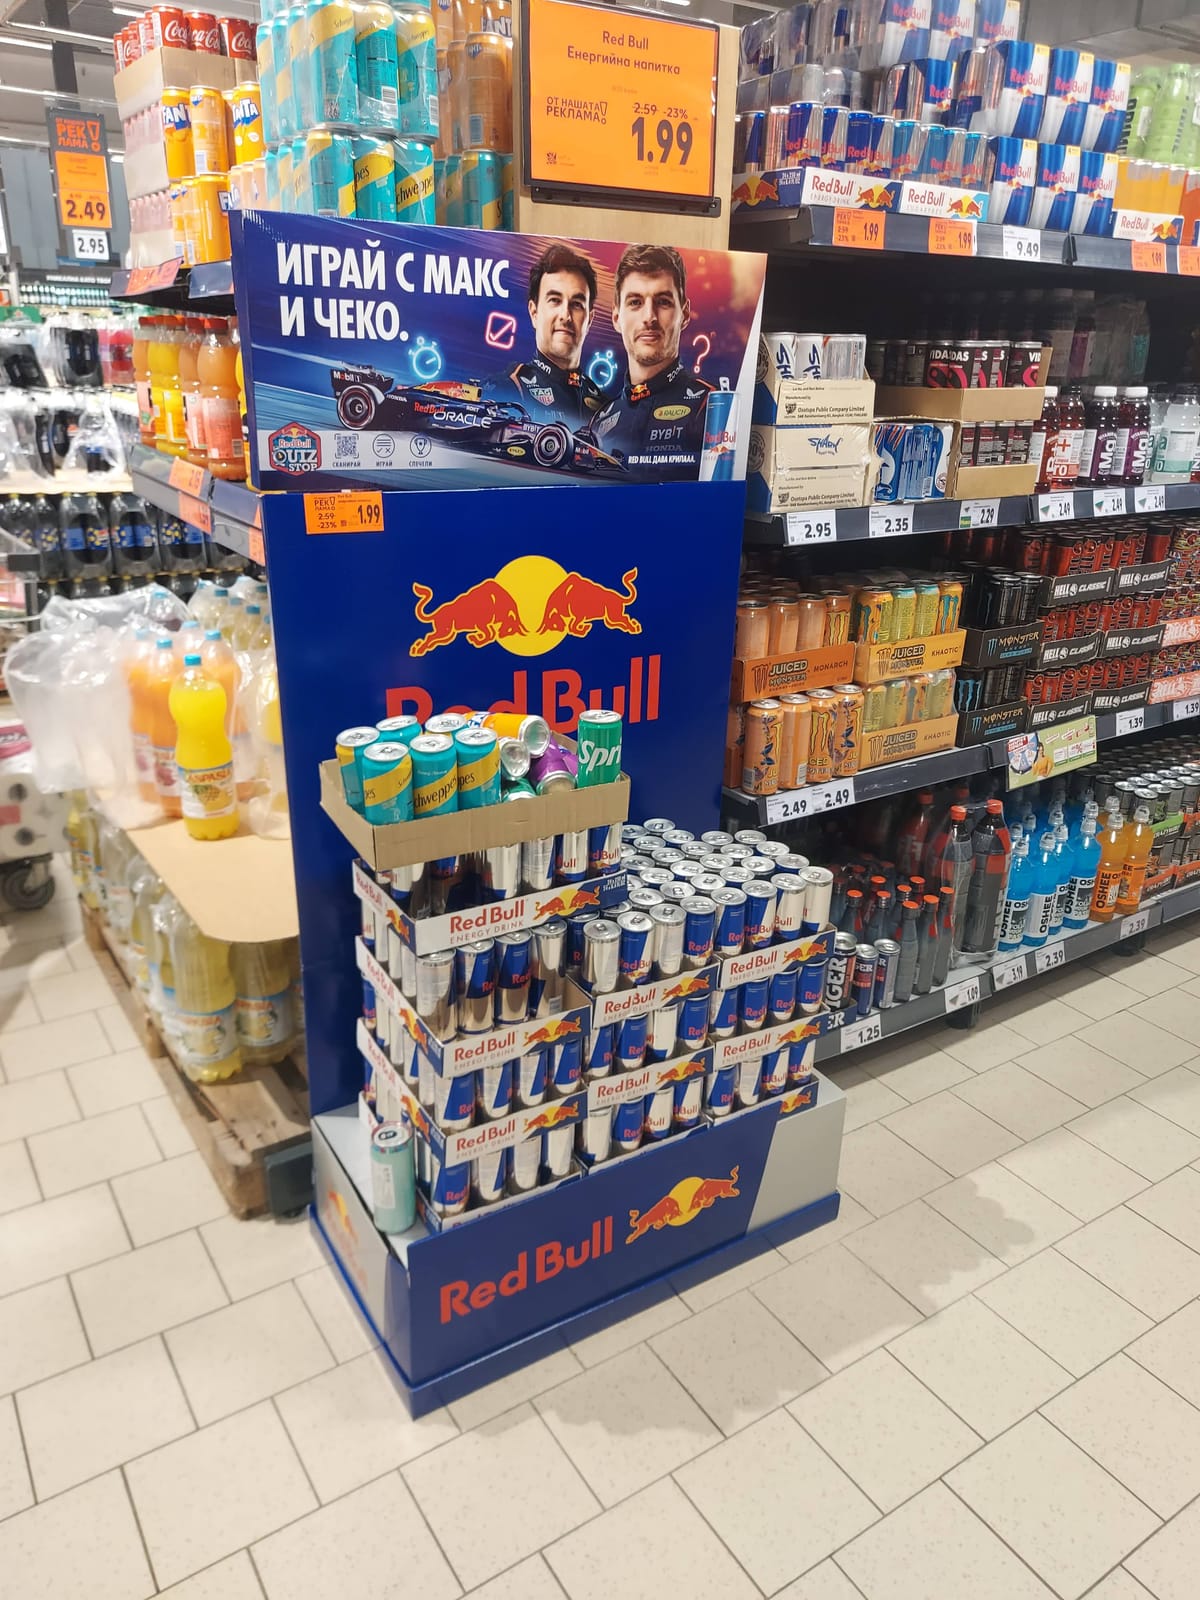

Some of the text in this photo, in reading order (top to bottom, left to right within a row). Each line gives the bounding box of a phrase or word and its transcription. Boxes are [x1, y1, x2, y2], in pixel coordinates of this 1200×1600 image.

[602, 31, 649, 50] Red Bull
[567, 46, 681, 75] Енергийна напитка
[546, 96, 600, 112] ОТ НАШАТА
[633, 102, 689, 120] 2.59 -23%
[546, 106, 601, 123] РЕКЛАМА
[632, 116, 693, 166] 1.99
[812, 176, 833, 192] Red
[834, 180, 853, 196] Bull
[908, 189, 945, 206] Red Bull
[65, 199, 106, 221] 2.49
[864, 222, 879, 241] 1.99
[77, 237, 105, 254] 2.95
[1017, 241, 1039, 257] 9.49
[277, 239, 510, 298] ИГРАЙ С МАКС
[280, 295, 409, 342] И ЧЕКО.
[433, 411, 493, 429] ORACLE
[289, 463, 318, 472] STOP
[358, 504, 380, 524] 1.99
[980, 509, 994, 525] 2.29
[1058, 502, 1070, 516] 2.49
[318, 521, 337, 529] -23%
[804, 523, 831, 539] 2.95
[885, 518, 909, 533] 2.35
[890, 644, 959, 660] JUICED KHAOTIC
[770, 660, 848, 676] JUICED MONARCH
[386, 671, 528, 726] Rd
[1094, 695, 1112, 707] HELL
[1185, 702, 1199, 714] 1.39
[1128, 717, 1144, 729] 1.39
[883, 730, 918, 745] JUICED
[579, 739, 621, 772] Spri
[824, 788, 850, 808] 2.49
[782, 799, 807, 817] 2.49
[1064, 878, 1078, 914] OSHEE
[1096, 872, 1111, 908] OSHEE
[450, 900, 525, 933] Red Bull
[1040, 895, 1053, 934] OSHEE
[450, 920, 524, 945] ENERGY DRINK
[1129, 918, 1145, 934] 2.39
[730, 950, 778, 975] Red Bull
[1045, 949, 1064, 968] 2.39
[1011, 965, 1024, 981] 3.19
[604, 988, 656, 1014] Red Bull
[967, 986, 980, 1001] 1.09
[858, 1025, 880, 1044] 1.25
[455, 1031, 515, 1061] Red Bull
[723, 1033, 771, 1057] Red Bull
[597, 1072, 649, 1098] Red Bull
[456, 1119, 515, 1151] Red Bull
[439, 1216, 614, 1325] Red Bull
